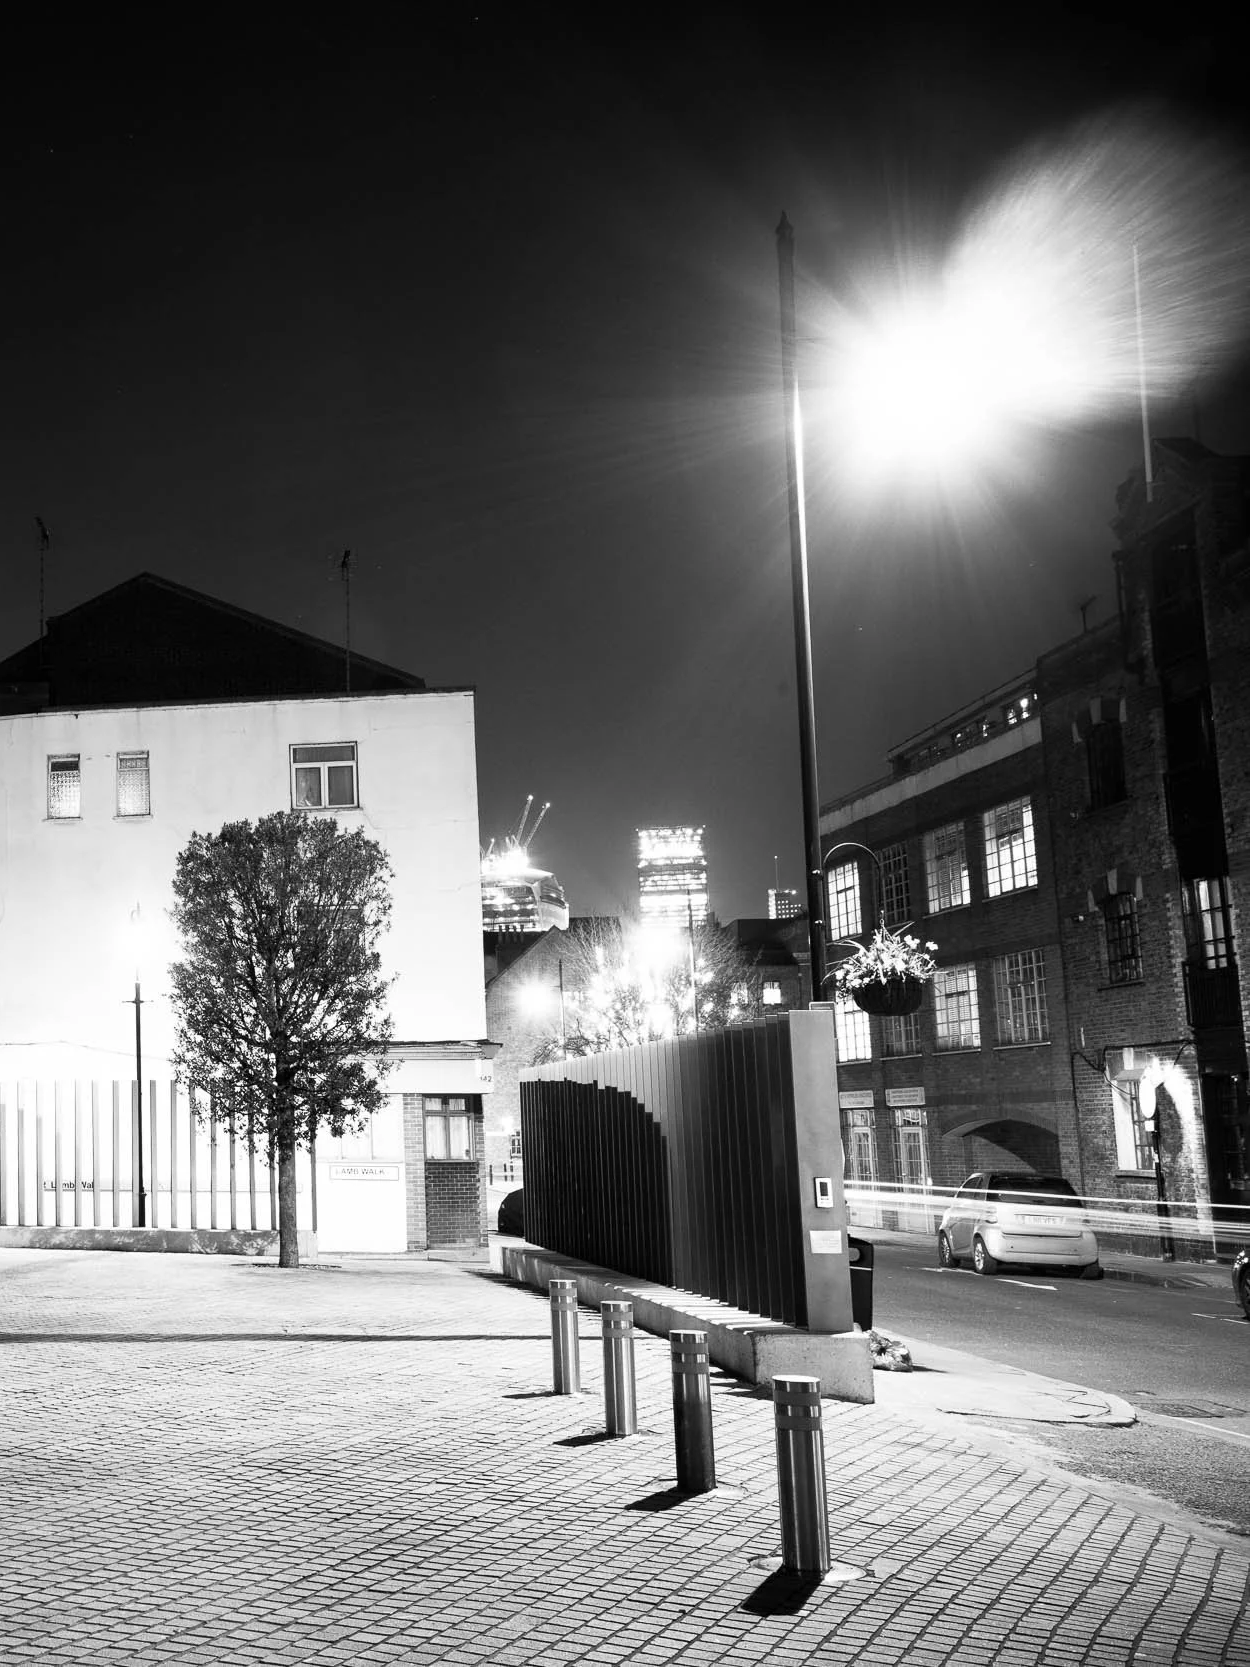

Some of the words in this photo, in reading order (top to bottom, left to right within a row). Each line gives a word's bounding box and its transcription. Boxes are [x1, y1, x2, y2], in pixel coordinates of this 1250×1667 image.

[335, 1168, 359, 1176] LAMB
[361, 1168, 385, 1176] WALK
[51, 1181, 75, 1189] Lmb
